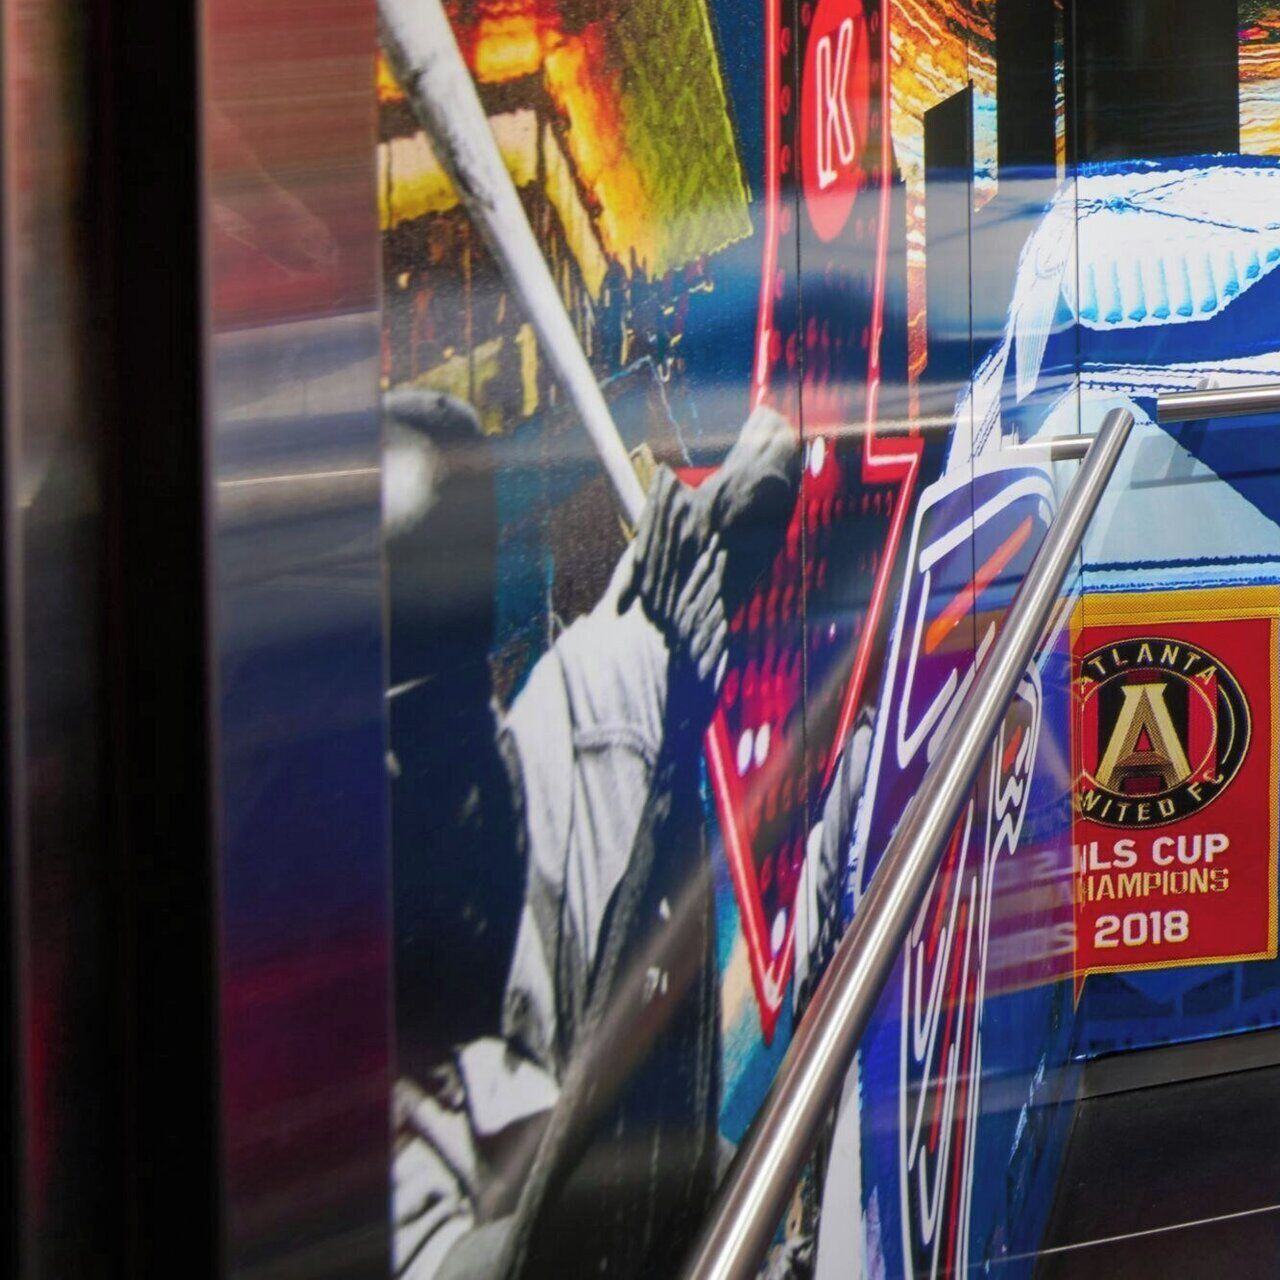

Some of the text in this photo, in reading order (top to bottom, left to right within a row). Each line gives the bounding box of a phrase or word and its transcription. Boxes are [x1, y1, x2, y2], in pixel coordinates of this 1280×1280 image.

[1081, 788, 1175, 822] NITED
[1152, 833, 1230, 866] CUP
[1081, 868, 1230, 902] HAMPIONS
[1094, 910, 1190, 949] 2018
